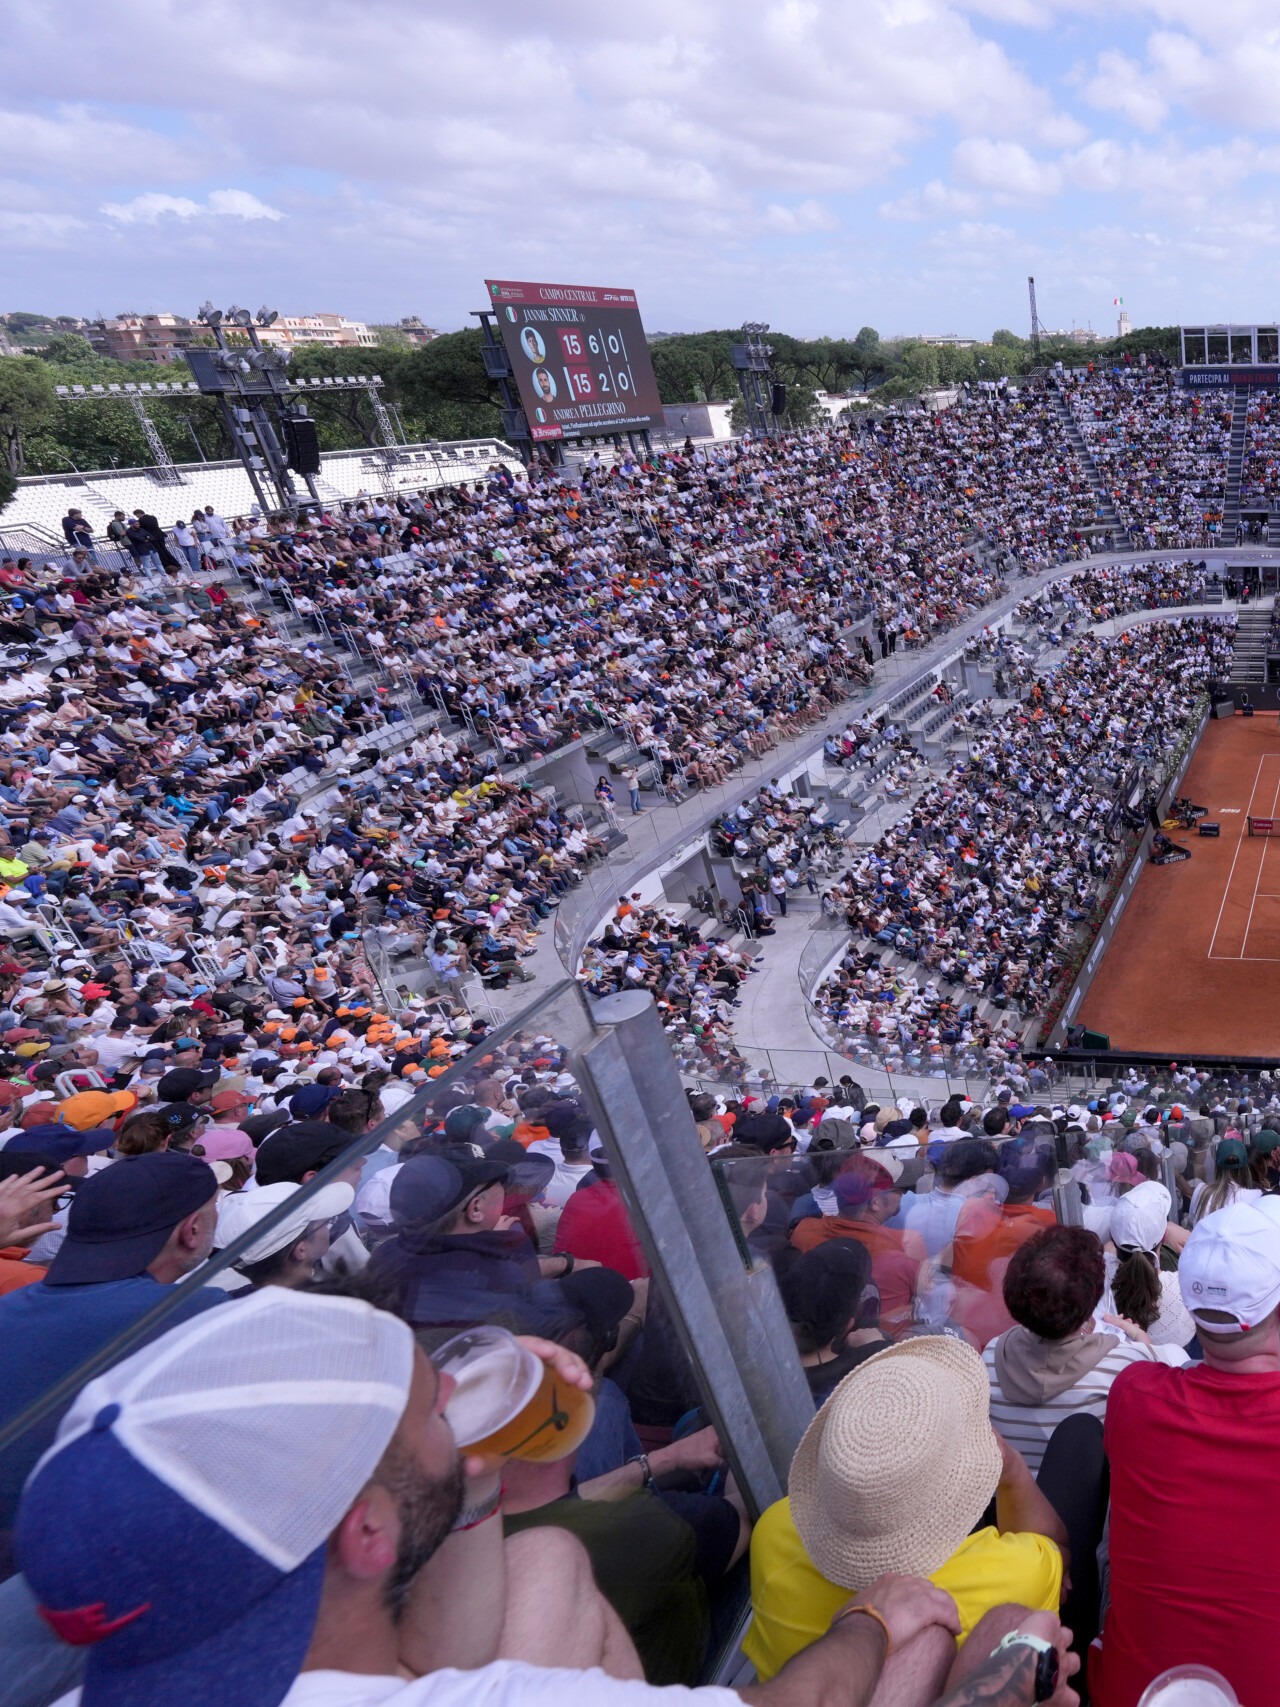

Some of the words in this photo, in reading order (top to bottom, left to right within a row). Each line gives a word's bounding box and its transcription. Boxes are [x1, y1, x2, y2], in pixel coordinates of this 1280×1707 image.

[539, 288, 564, 300] CAMPO
[564, 290, 598, 302] CENTRALE
[522, 308, 548, 322] JANNIK
[548, 307, 579, 322] SINNER
[563, 335, 581, 355] 15
[588, 335, 599, 354] 6
[608, 335, 619, 354] 0
[573, 374, 591, 393] 15
[599, 373, 610, 391] 2
[618, 372, 629, 390] 0
[1190, 374, 1222, 383] PARTECIPA
[1222, 374, 1229, 383] AI
[553, 408, 579, 420] ANDREA
[579, 402, 626, 418] PELLEGRINO
